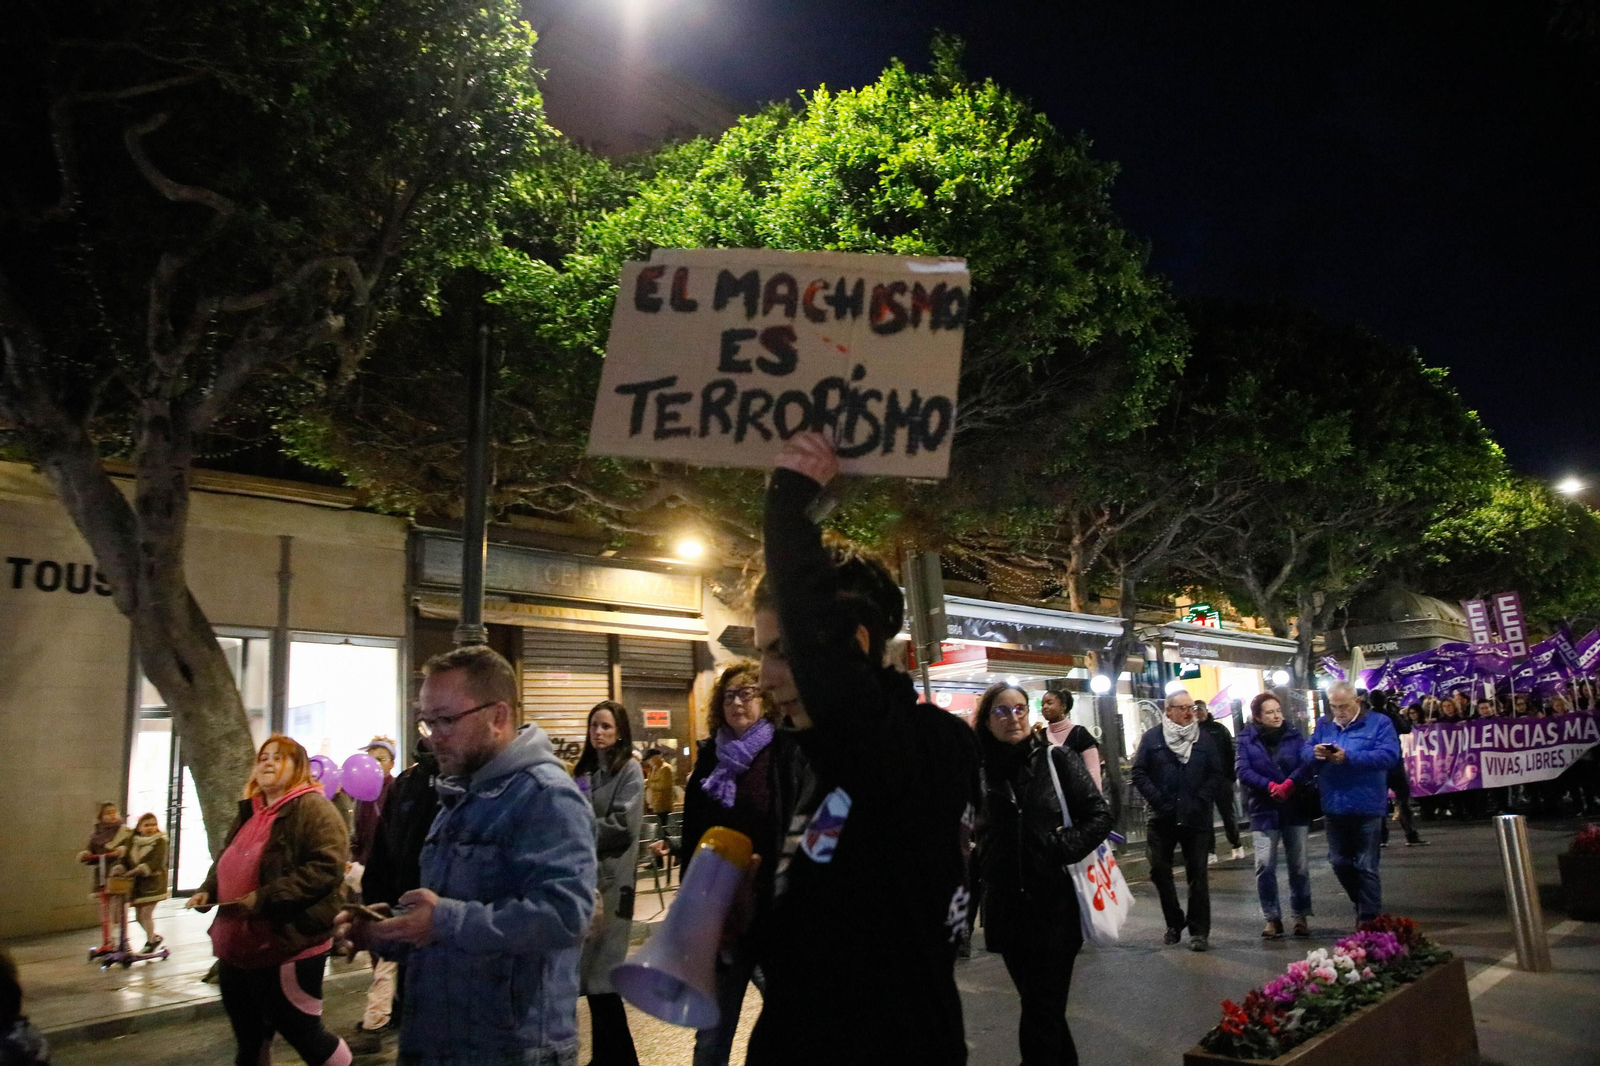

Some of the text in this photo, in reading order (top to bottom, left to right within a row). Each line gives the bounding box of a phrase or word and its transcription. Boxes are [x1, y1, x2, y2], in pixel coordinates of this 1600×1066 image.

[634, 264, 967, 336] EL MACHISMO
[717, 325, 798, 375] ES
[1467, 603, 1490, 644] CCO
[1497, 595, 1527, 657] CCOO
[1442, 722, 1559, 754] VIOLENCIAS
[1485, 755, 1524, 776] VIVAS,
